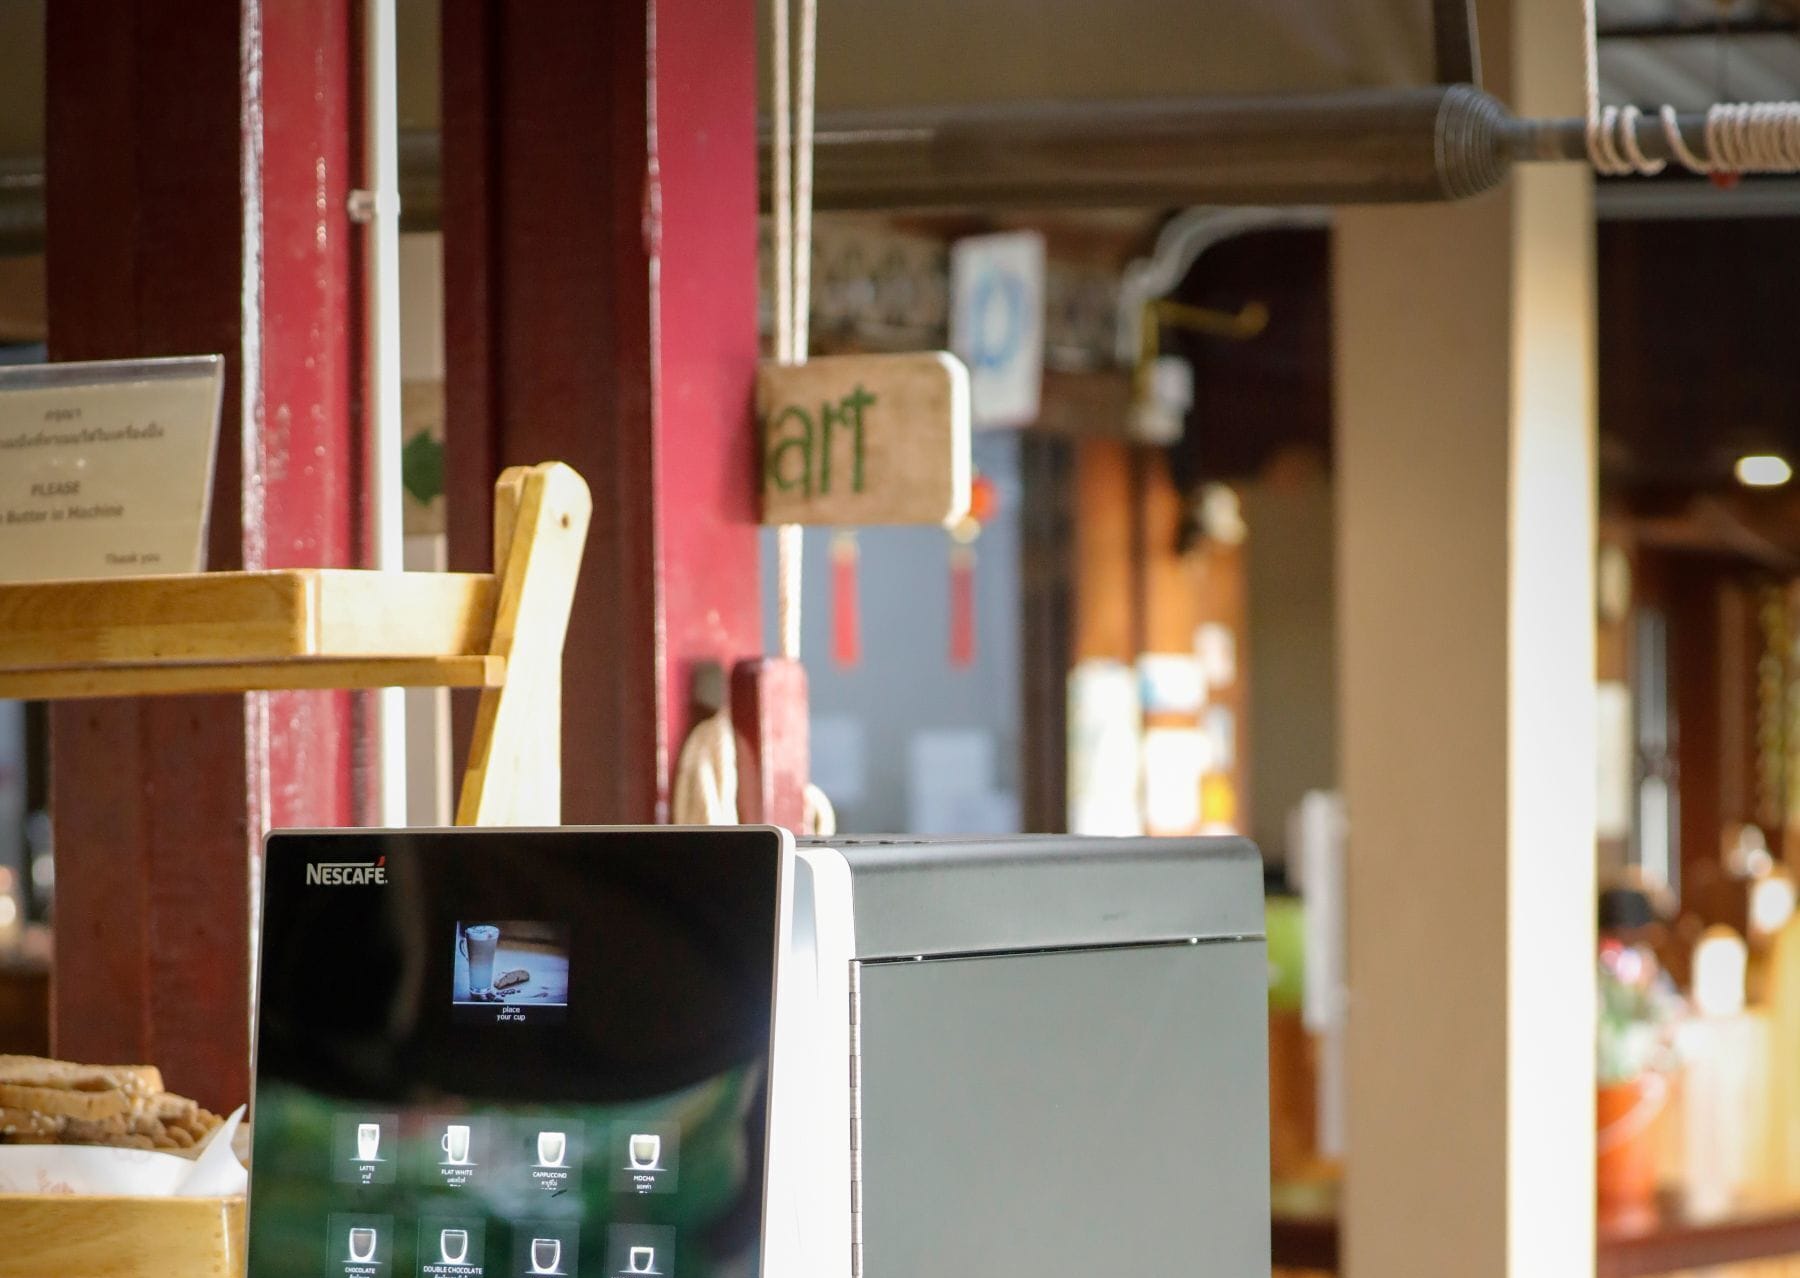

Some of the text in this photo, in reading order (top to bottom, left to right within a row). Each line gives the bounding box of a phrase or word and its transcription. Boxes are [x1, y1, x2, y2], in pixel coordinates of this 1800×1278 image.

[758, 384, 876, 499] art
[31, 481, 80, 496] PLEASE
[502, 1006, 521, 1014] place
[532, 1171, 567, 1179] CAPPUCCINO
[345, 1266, 375, 1274] CHOCOLATE
[423, 1265, 483, 1275] DOUBLE CHOCOLATE
